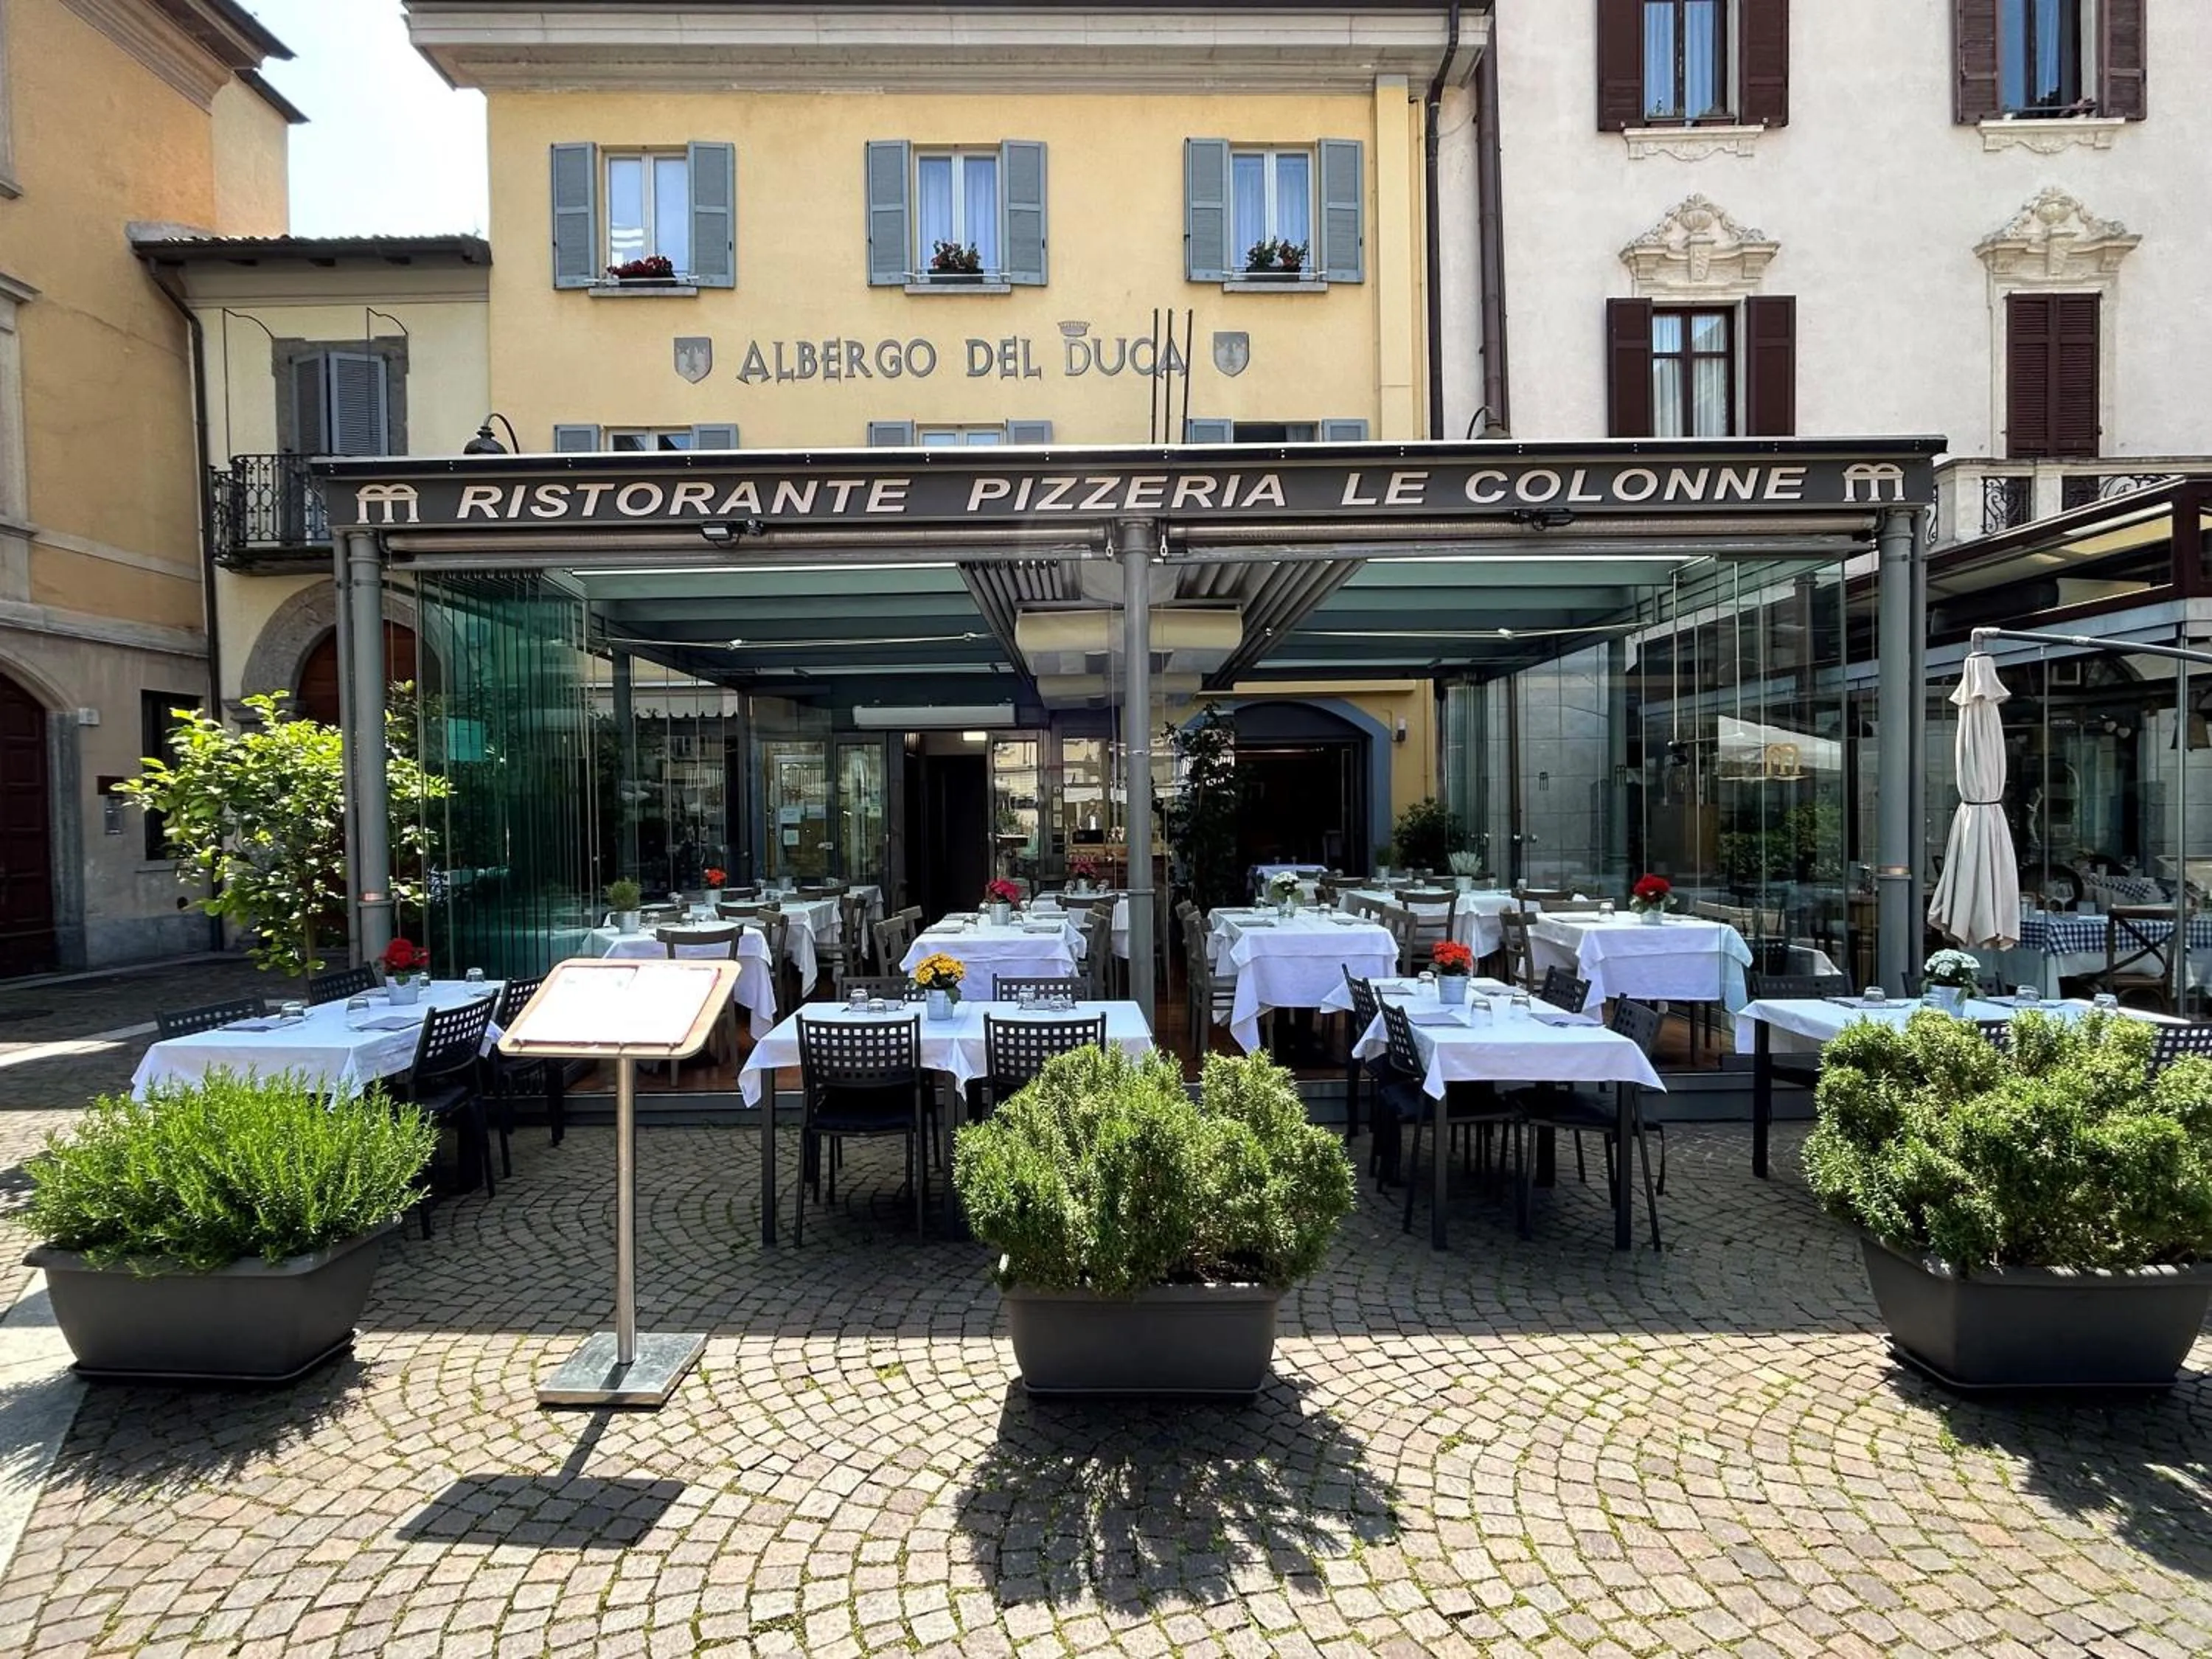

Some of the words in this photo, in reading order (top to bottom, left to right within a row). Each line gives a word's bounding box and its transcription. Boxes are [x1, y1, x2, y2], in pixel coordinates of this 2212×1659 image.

[737, 338, 936, 383] ALBERGO
[966, 335, 1042, 380] DEL
[1065, 335, 1189, 379] DUCA
[456, 479, 913, 519] RISTORANTE
[966, 473, 1288, 512] PIZZERIA
[1340, 471, 1428, 506] LE
[1464, 467, 1806, 503] COLONNE
